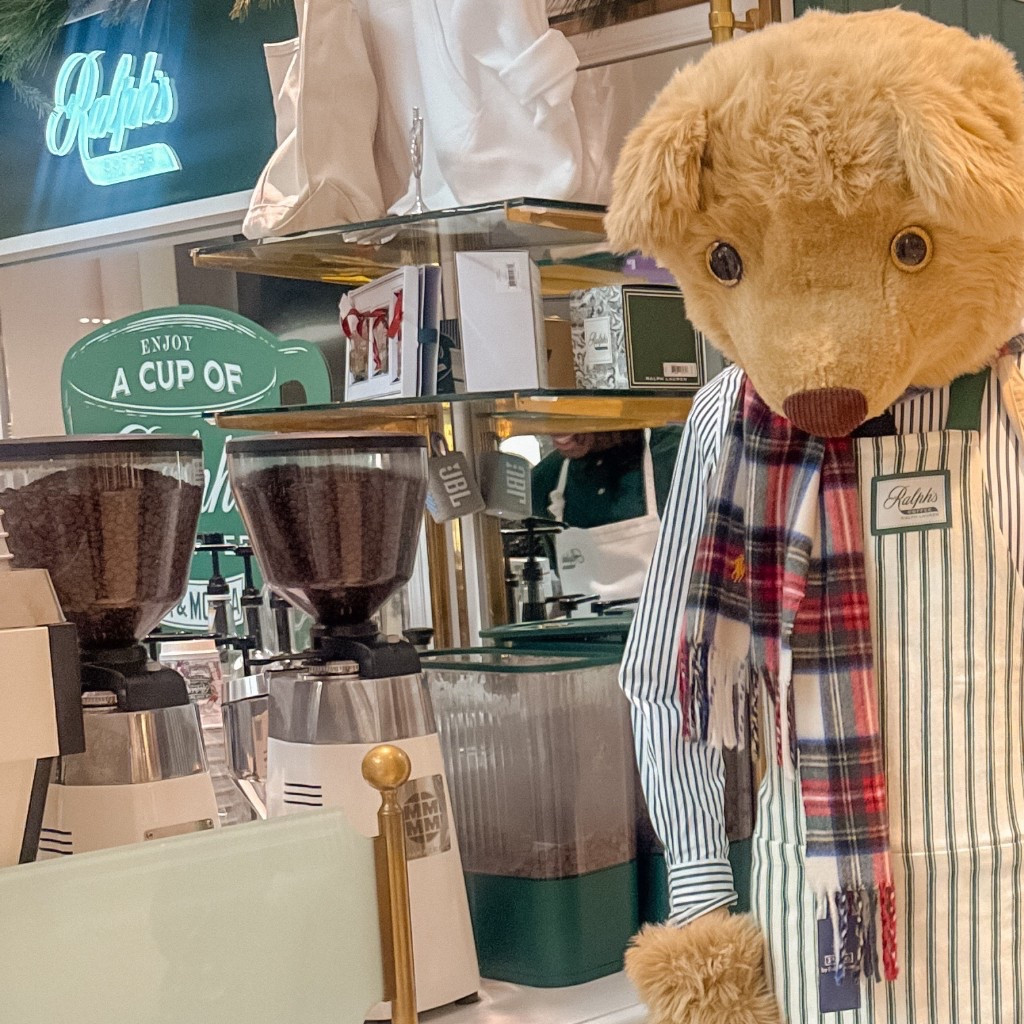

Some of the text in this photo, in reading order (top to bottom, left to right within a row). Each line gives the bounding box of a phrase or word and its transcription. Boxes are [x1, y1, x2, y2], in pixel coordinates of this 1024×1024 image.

[46, 50, 176, 156] Ralph's
[140, 334, 193, 356] ENJOY
[111, 359, 244, 399] A CUP OF
[439, 462, 471, 508] JBL
